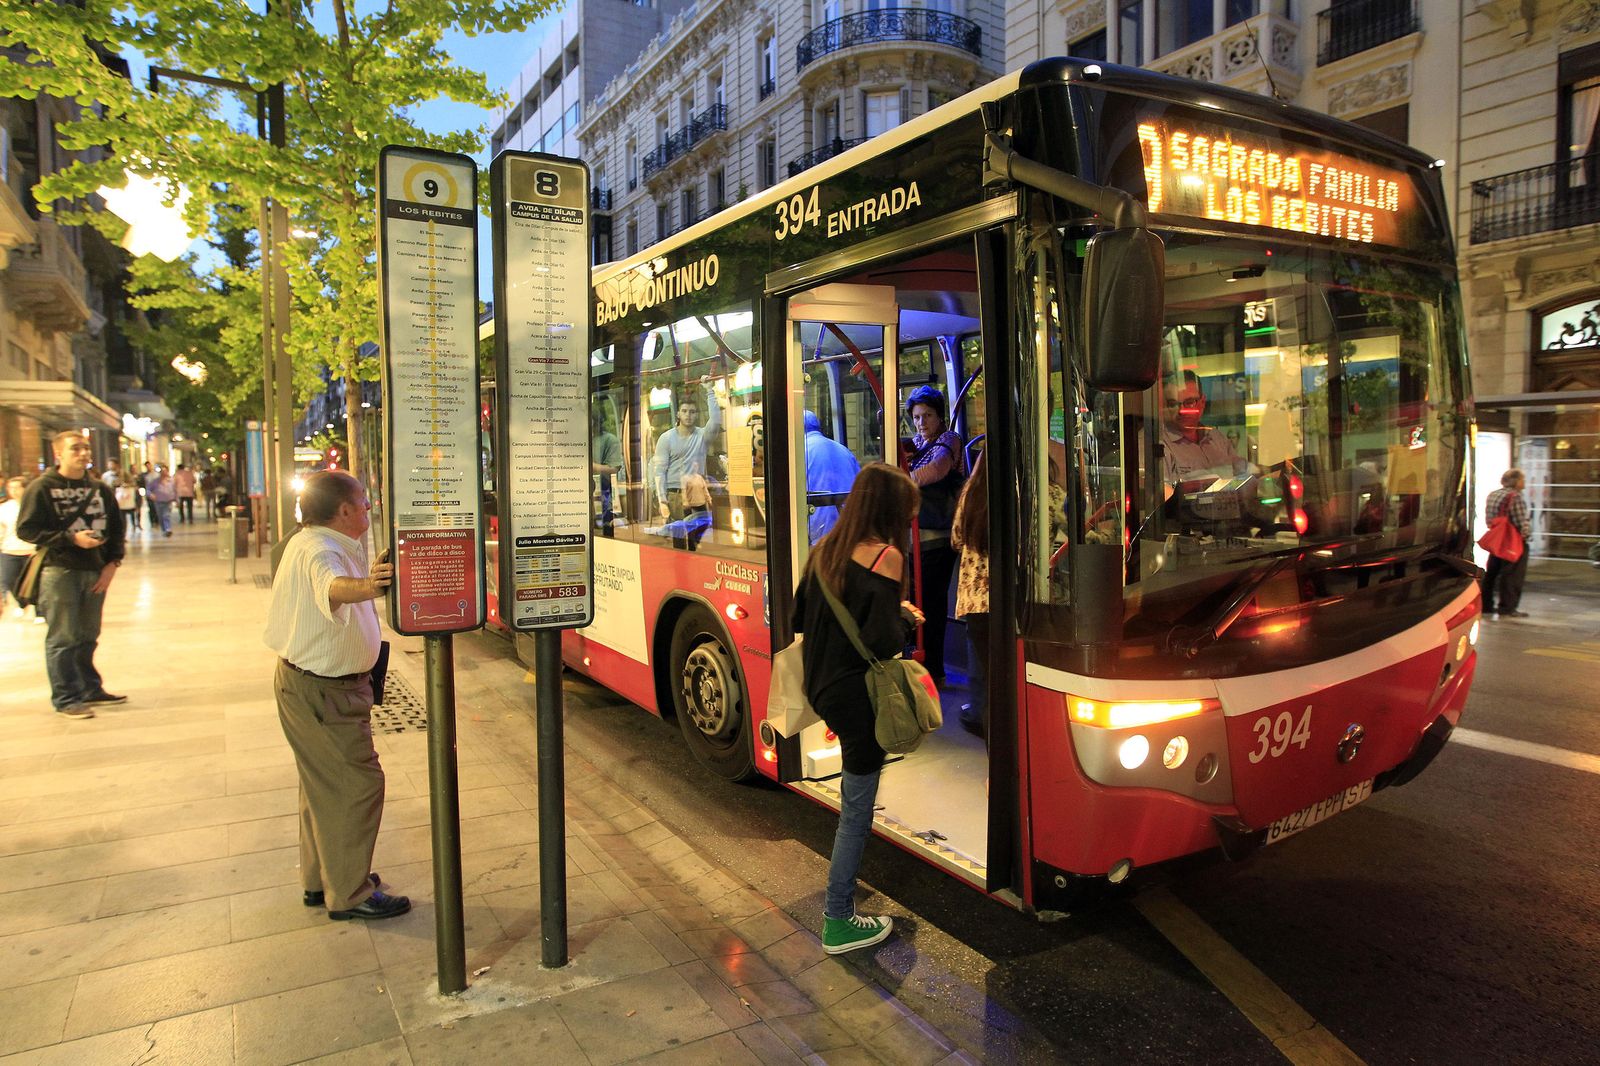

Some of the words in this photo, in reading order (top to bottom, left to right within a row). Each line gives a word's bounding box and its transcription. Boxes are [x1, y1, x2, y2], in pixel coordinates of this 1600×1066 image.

[536, 172, 558, 196] 8
[1170, 132, 1299, 192] SAGRADA
[1309, 163, 1399, 211] FAMILIA
[424, 180, 438, 197] 9
[422, 209, 462, 220] REBITES
[518, 204, 539, 213] AVDA.
[555, 206, 576, 216] DÍLAR
[774, 186, 821, 240] 394
[828, 182, 921, 238] ENTRADA
[1207, 184, 1261, 224] LOS
[1272, 195, 1374, 243] REBITES
[597, 296, 628, 326] BAJO
[731, 508, 744, 544] 9
[608, 565, 615, 577] TE
[716, 561, 760, 582] CityClass
[559, 587, 578, 597] 583
[1249, 704, 1312, 764] 394
[1272, 805, 1312, 839] 6427
